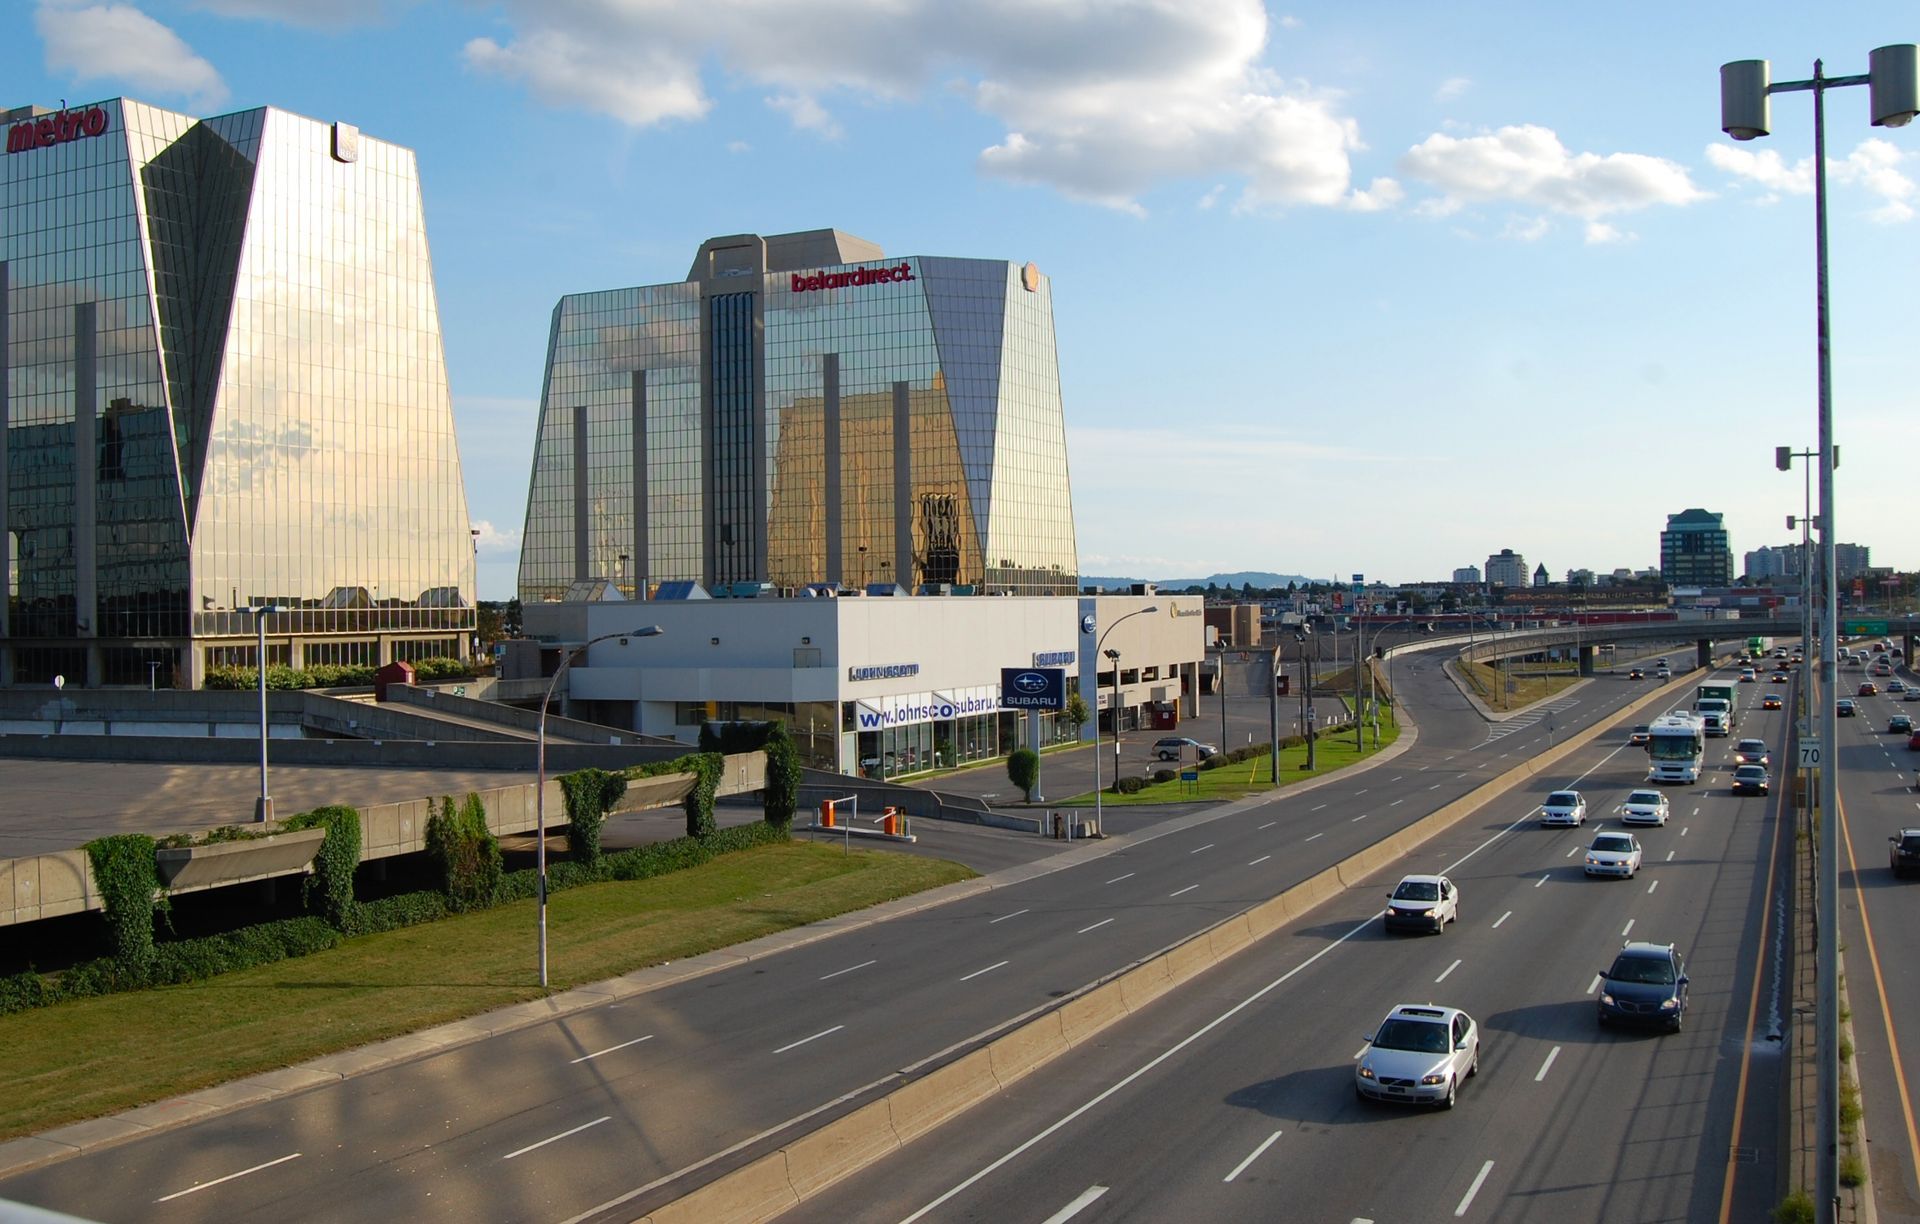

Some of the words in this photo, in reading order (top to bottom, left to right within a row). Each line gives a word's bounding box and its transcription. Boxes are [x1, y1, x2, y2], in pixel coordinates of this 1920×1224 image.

[7, 107, 106, 153] metro
[1036, 651, 1075, 667] SUBARU
[1006, 696, 1057, 705] SUBARU
[1801, 749, 1820, 763] 70
